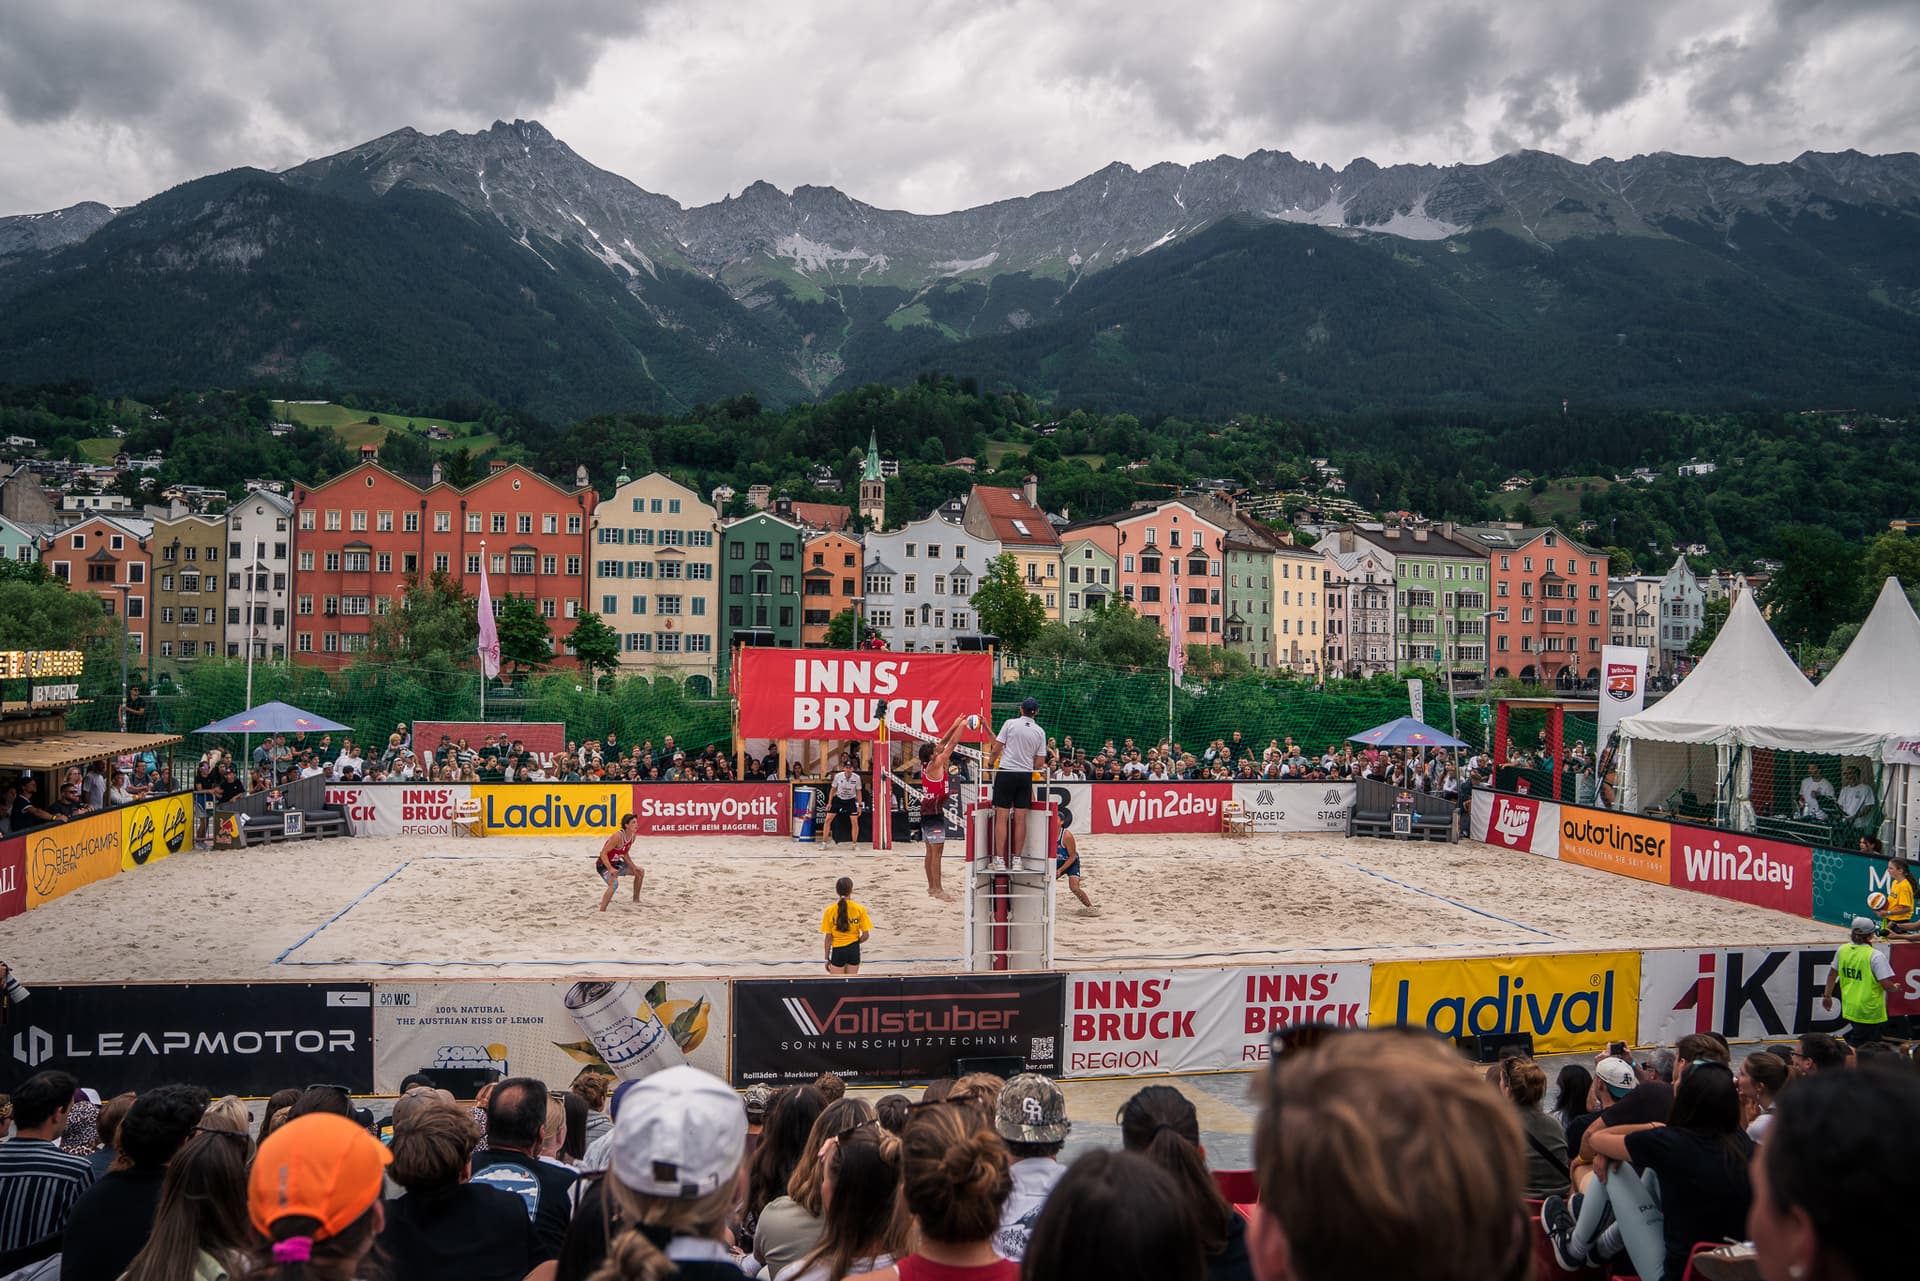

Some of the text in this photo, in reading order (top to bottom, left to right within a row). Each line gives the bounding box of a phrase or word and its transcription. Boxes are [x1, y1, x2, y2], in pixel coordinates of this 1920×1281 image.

[794, 659, 910, 695] INNS'
[54, 684, 79, 700] PENZ
[793, 697, 940, 733] BRUCK
[325, 790, 362, 805] NS'
[402, 790, 453, 805] INNS'
[487, 794, 617, 828] Ladival
[641, 796, 778, 821] StastnyOptik
[1245, 811, 1285, 820] STAGE12
[652, 824, 676, 832] KLARE
[678, 824, 699, 832] SICHT
[722, 823, 760, 831] BAGGERN.
[56, 832, 119, 866] BEACHCAMPS
[1074, 978, 1171, 1010] INNS'
[1246, 973, 1338, 1003] INNS'
[394, 993, 411, 1006] WC
[436, 1006, 505, 1014] 100% NATURAL
[397, 1016, 544, 1025] THE AUSTRIAN KISS OF LEMON
[1073, 1011, 1197, 1042] BRUCK
[67, 1030, 355, 1057] LEAPMOTOR
[781, 1034, 1018, 1051] SONNENSCHUTZTECHNIK
[1071, 1050, 1159, 1070] REGION
[784, 1070, 819, 1078] Markisen
